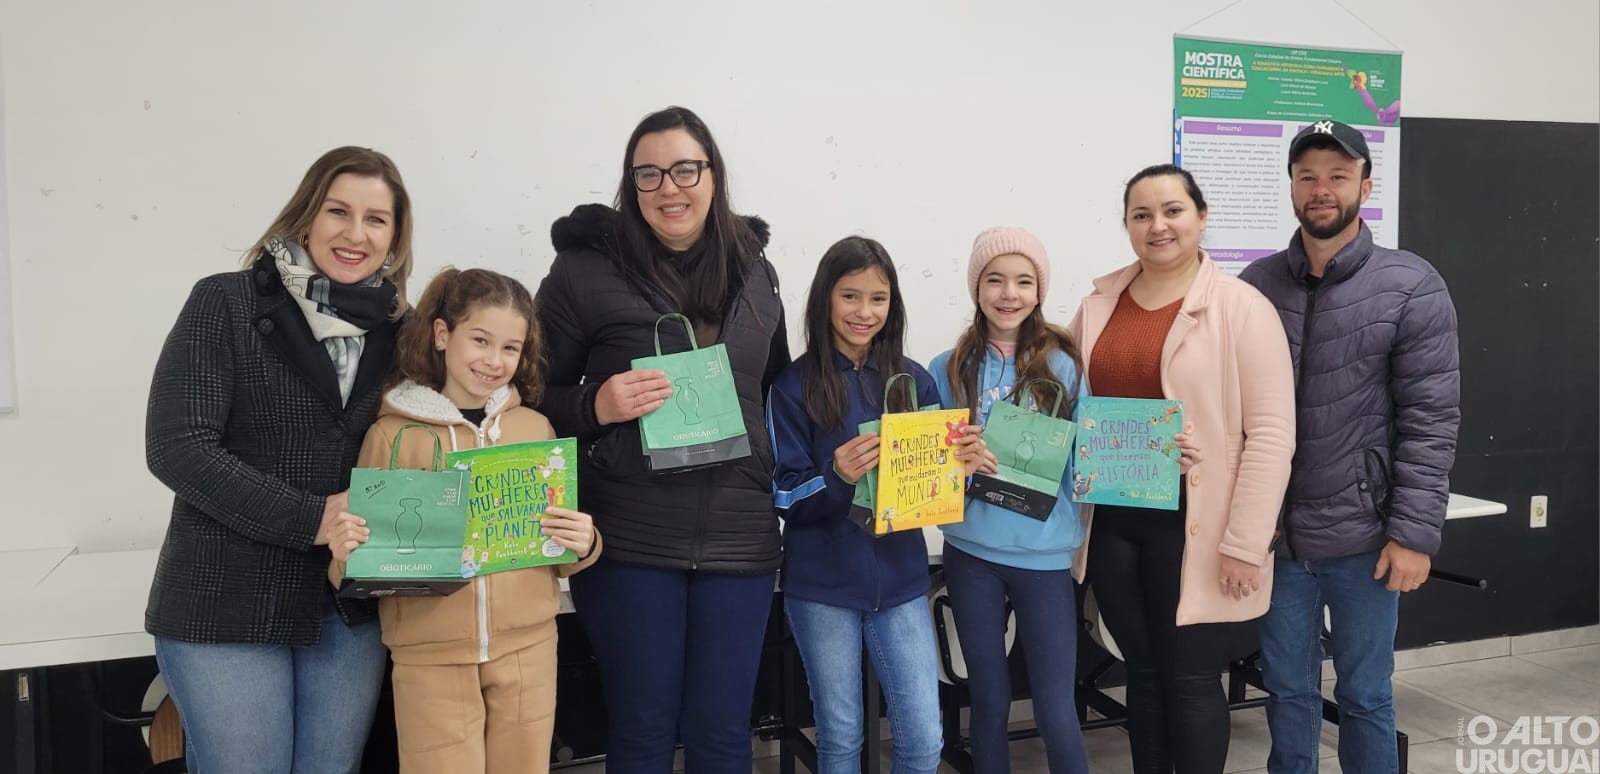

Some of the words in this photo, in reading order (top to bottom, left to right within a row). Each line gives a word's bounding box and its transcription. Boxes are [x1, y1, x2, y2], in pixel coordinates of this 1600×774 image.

[1185, 51, 1243, 67] MOSTRA
[1182, 65, 1245, 79] CIENTÍFICA
[1182, 87, 1208, 98] 2025
[1097, 461, 1160, 483] HISTÓRIA
[897, 476, 942, 512] MUNDO
[481, 512, 496, 522] que
